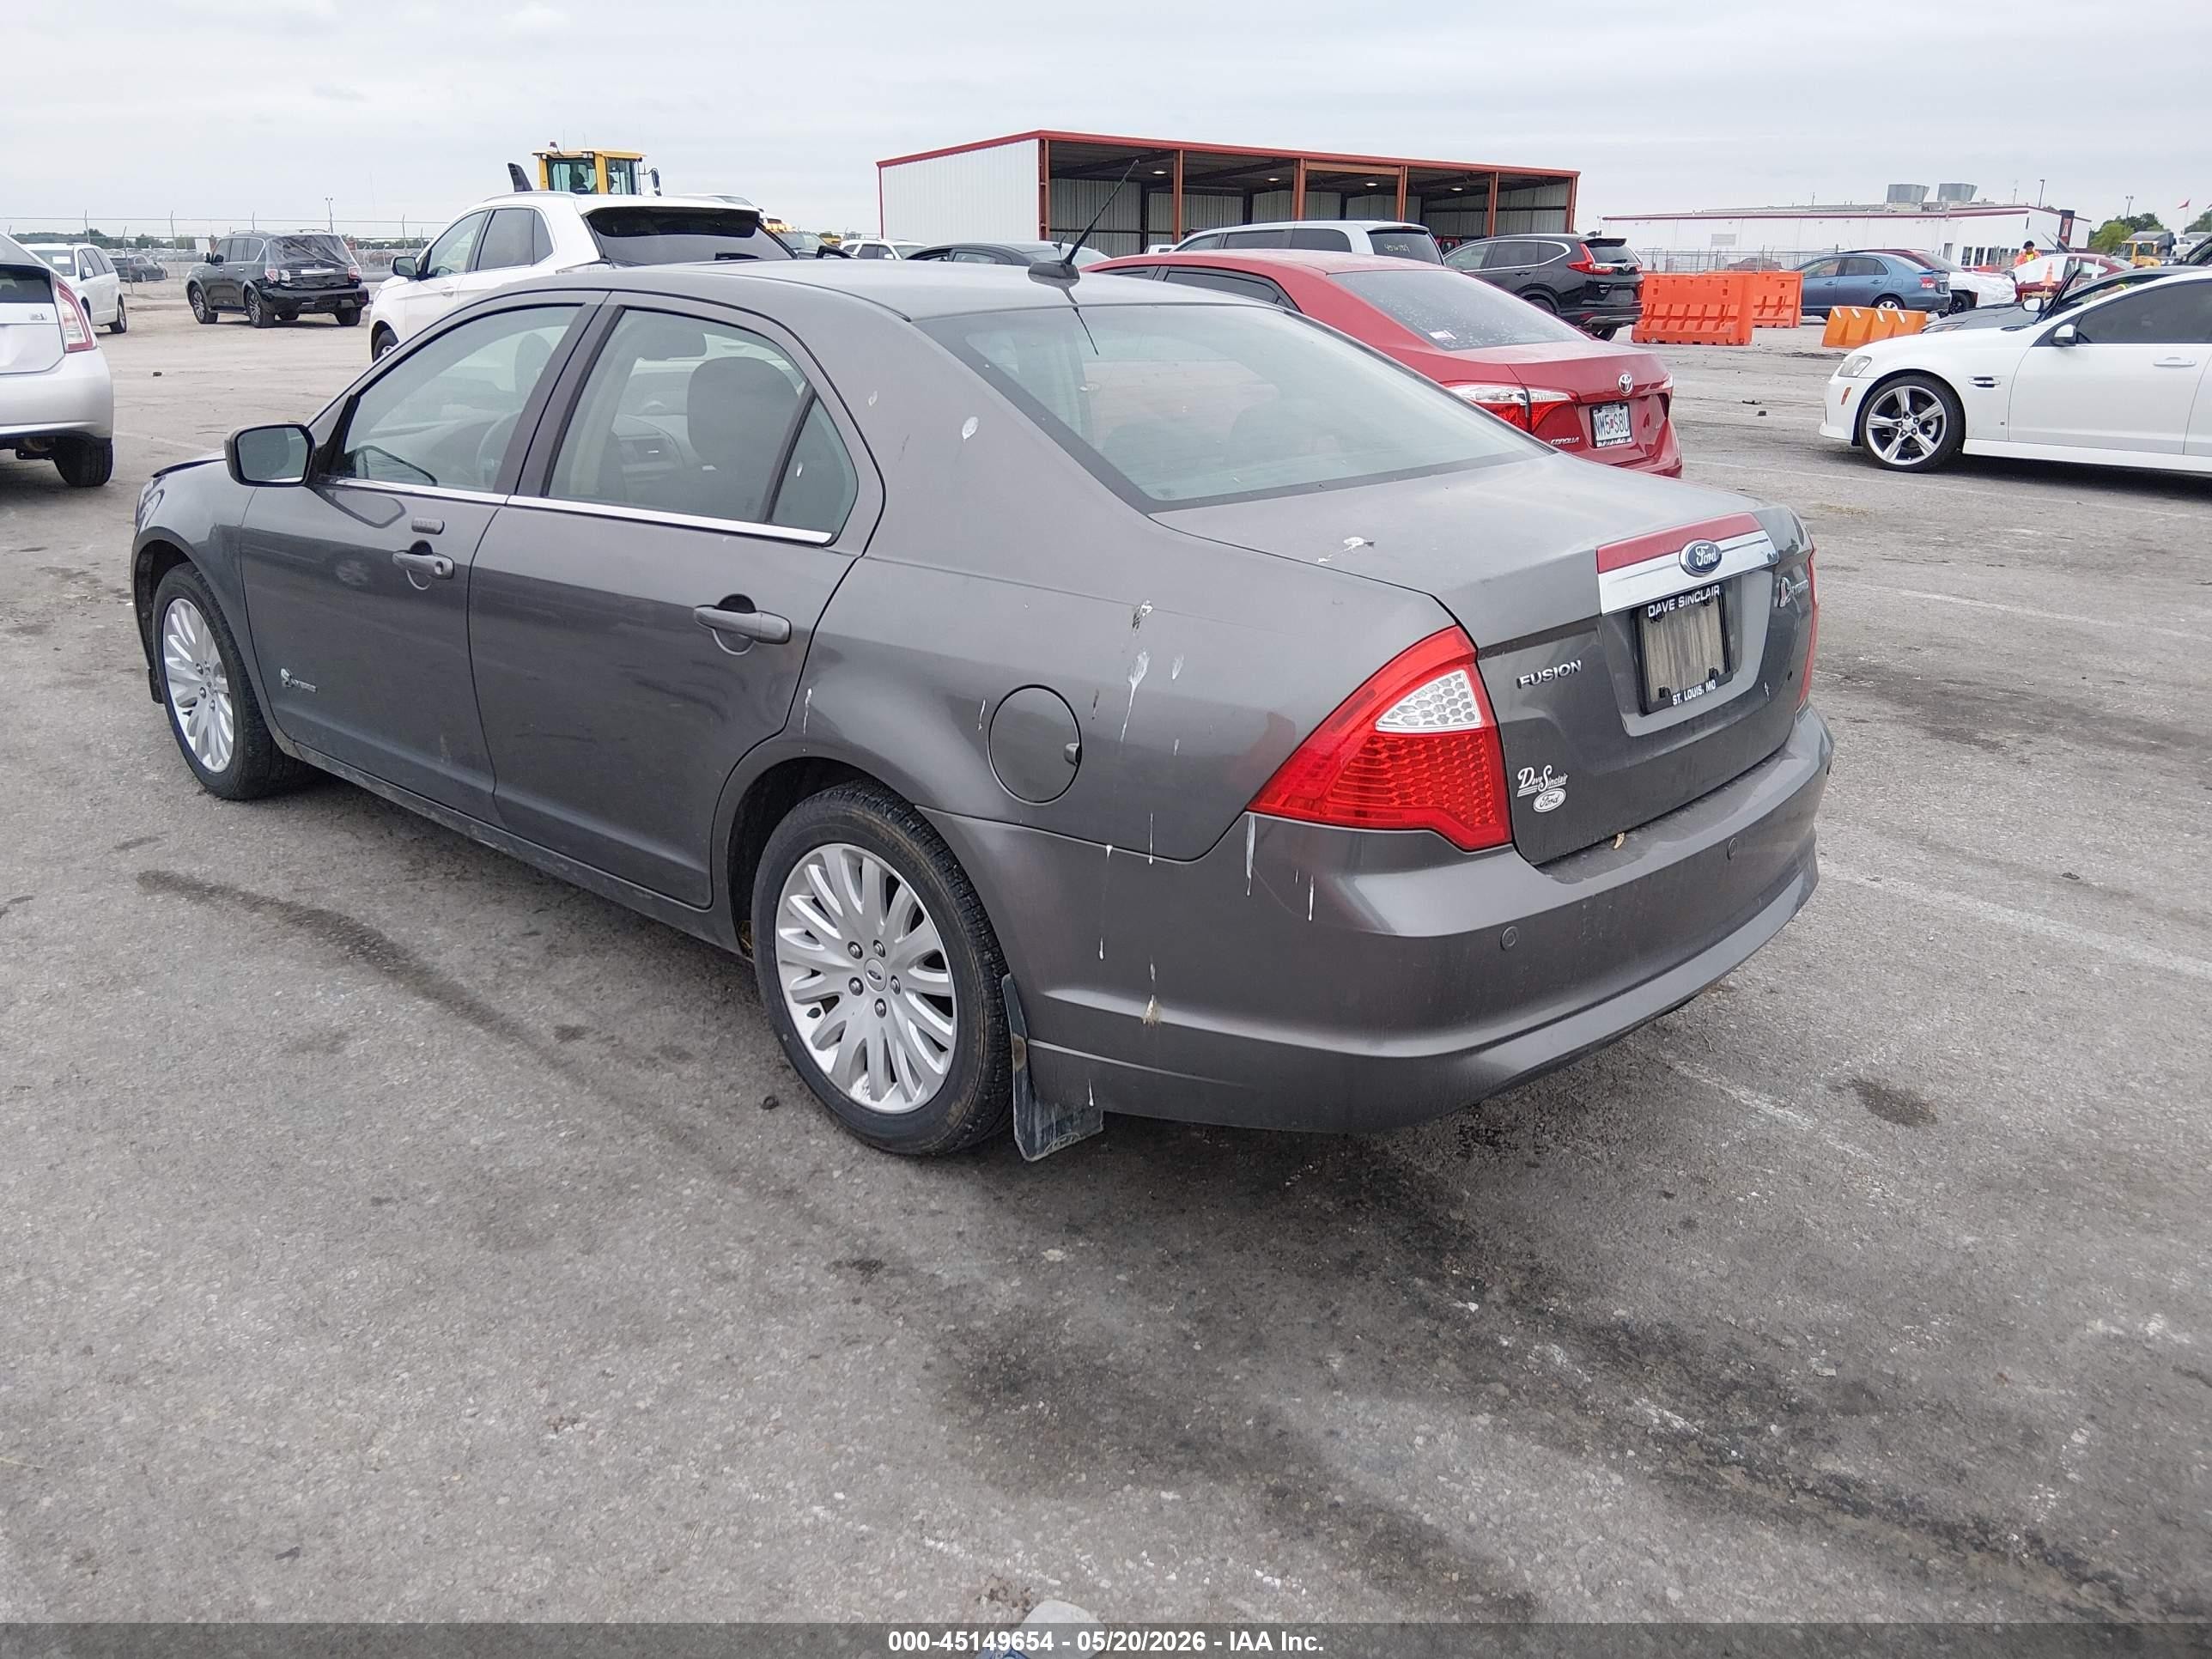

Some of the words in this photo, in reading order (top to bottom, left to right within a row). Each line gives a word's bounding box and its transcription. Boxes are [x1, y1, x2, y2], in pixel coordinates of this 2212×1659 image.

[1695, 545, 1718, 567] Ford
[1647, 598, 1676, 617] DAVE
[1678, 584, 1721, 608] SINCLAIR
[1516, 659, 1582, 689] FUSION
[1672, 692, 1683, 706] ST.
[1705, 678, 1717, 693] MO
